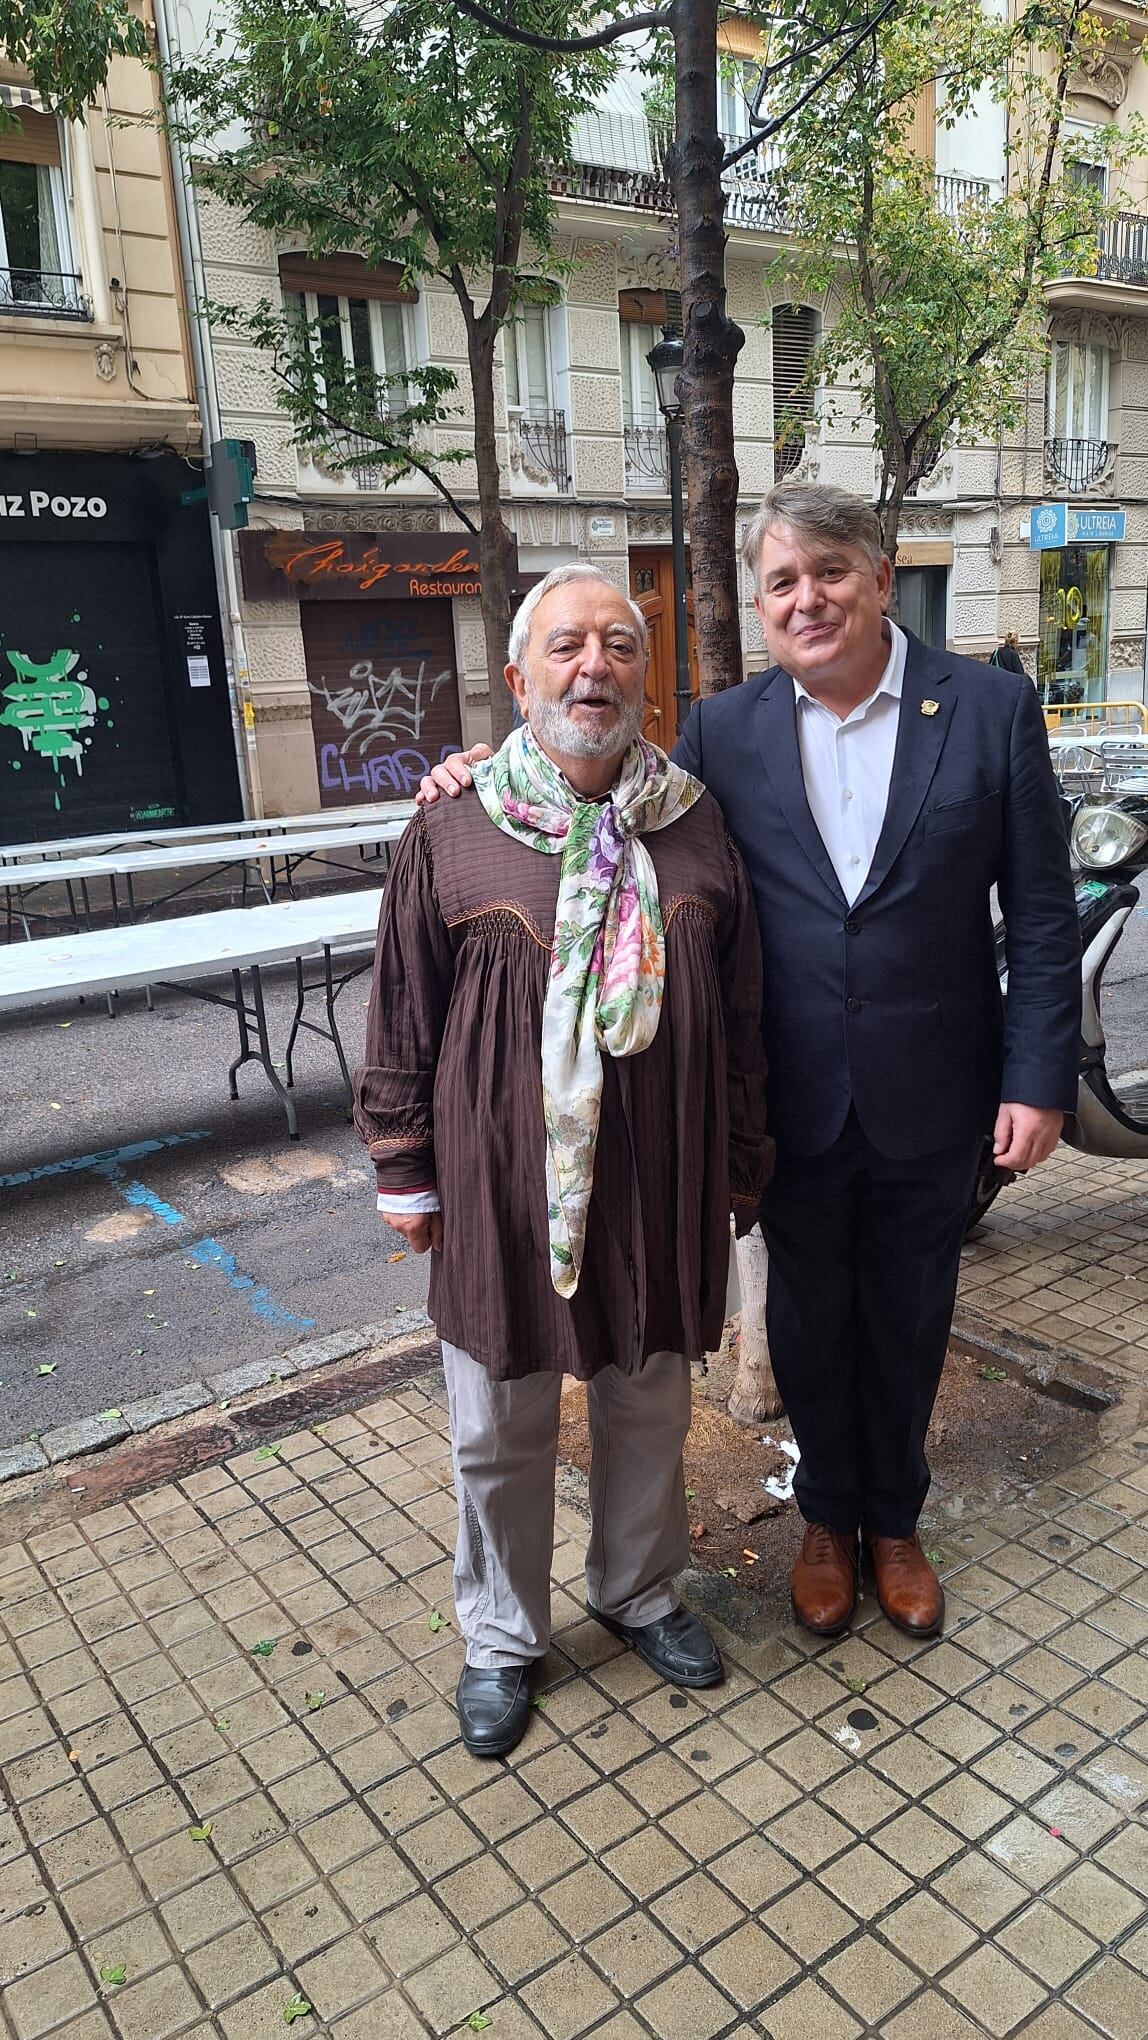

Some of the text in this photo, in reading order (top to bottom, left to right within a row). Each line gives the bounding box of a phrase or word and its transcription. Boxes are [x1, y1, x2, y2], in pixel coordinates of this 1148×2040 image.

[29, 490, 108, 518] Pozo
[1080, 515, 1117, 530] ULTREIA
[1034, 533, 1059, 543] ULTREIA
[410, 579, 482, 596] Restauran
[320, 744, 461, 793] CHAP
